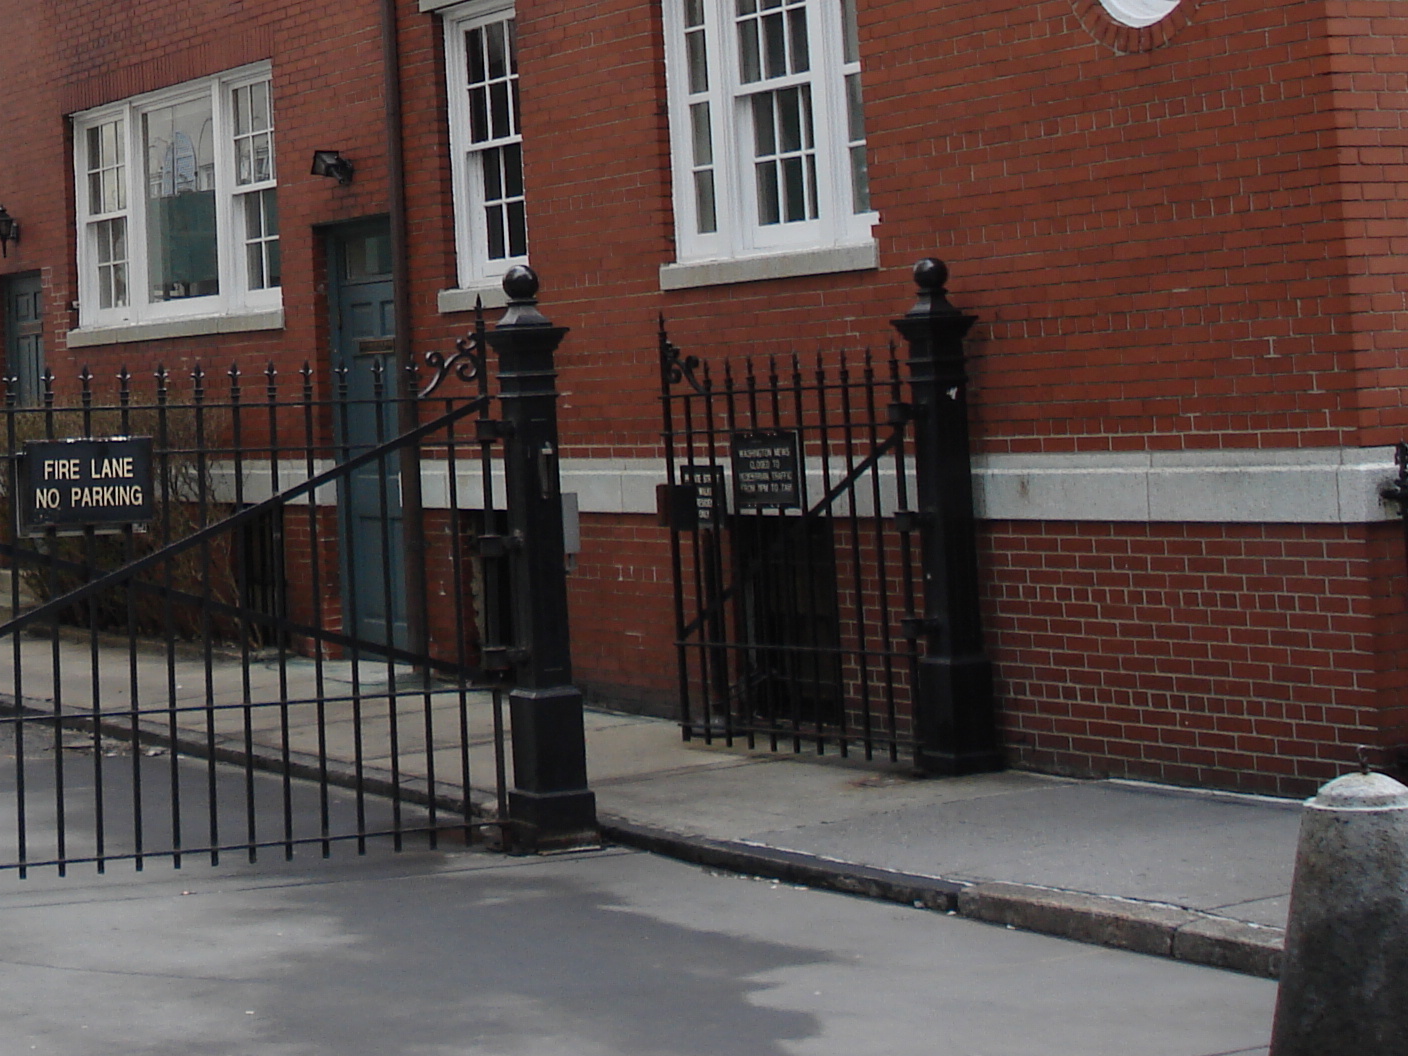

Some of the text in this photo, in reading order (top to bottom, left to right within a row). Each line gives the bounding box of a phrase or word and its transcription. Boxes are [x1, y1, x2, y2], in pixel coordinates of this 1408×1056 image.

[44, 457, 134, 480] FIRE LANE
[36, 485, 143, 509] NO PARKING
